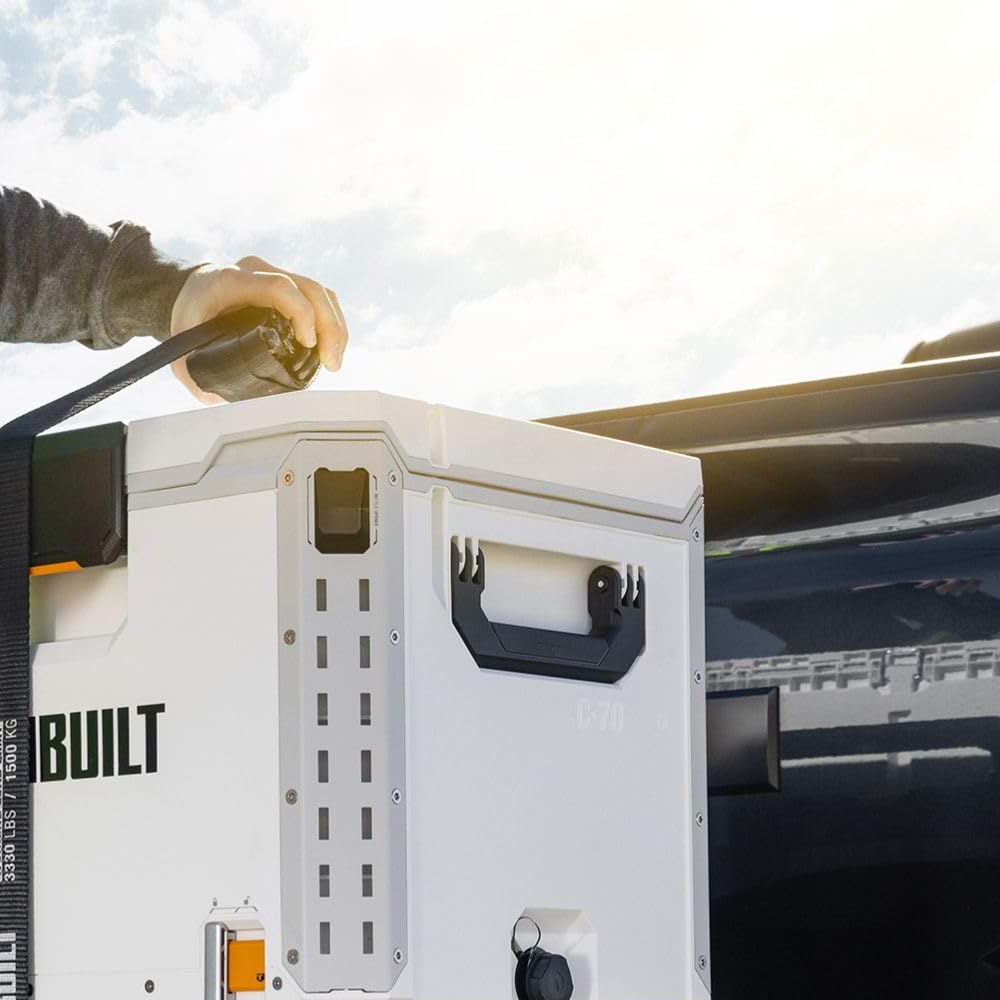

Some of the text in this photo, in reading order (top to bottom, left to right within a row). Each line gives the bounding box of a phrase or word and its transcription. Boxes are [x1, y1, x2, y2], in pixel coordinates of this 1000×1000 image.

[4, 719, 17, 738] KG
[4, 744, 17, 782] 1500
[4, 810, 16, 839] LBS
[4, 844, 16, 882] 3330
